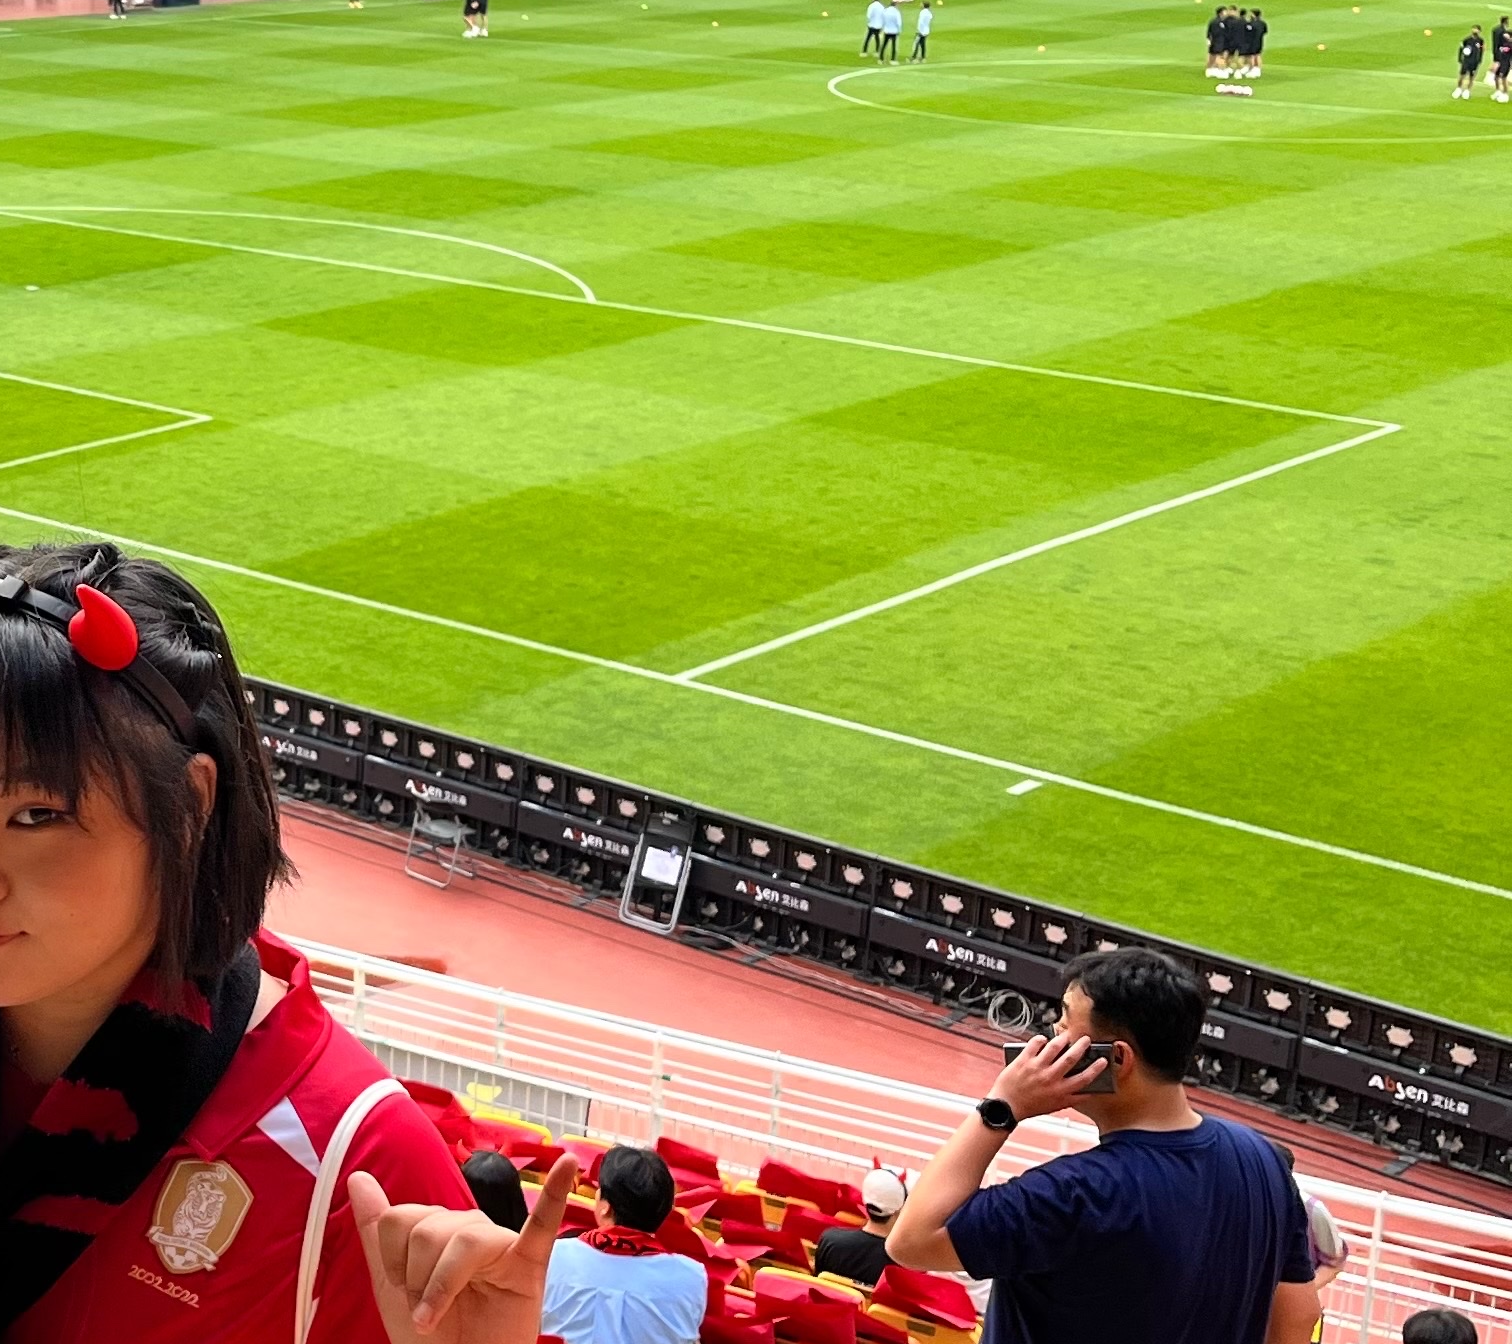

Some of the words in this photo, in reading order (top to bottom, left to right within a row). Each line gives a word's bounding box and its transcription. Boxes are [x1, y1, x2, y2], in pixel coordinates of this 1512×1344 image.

[735, 879, 780, 904] Absen
[925, 937, 975, 963] Absen
[1368, 1073, 1429, 1104] Absen
